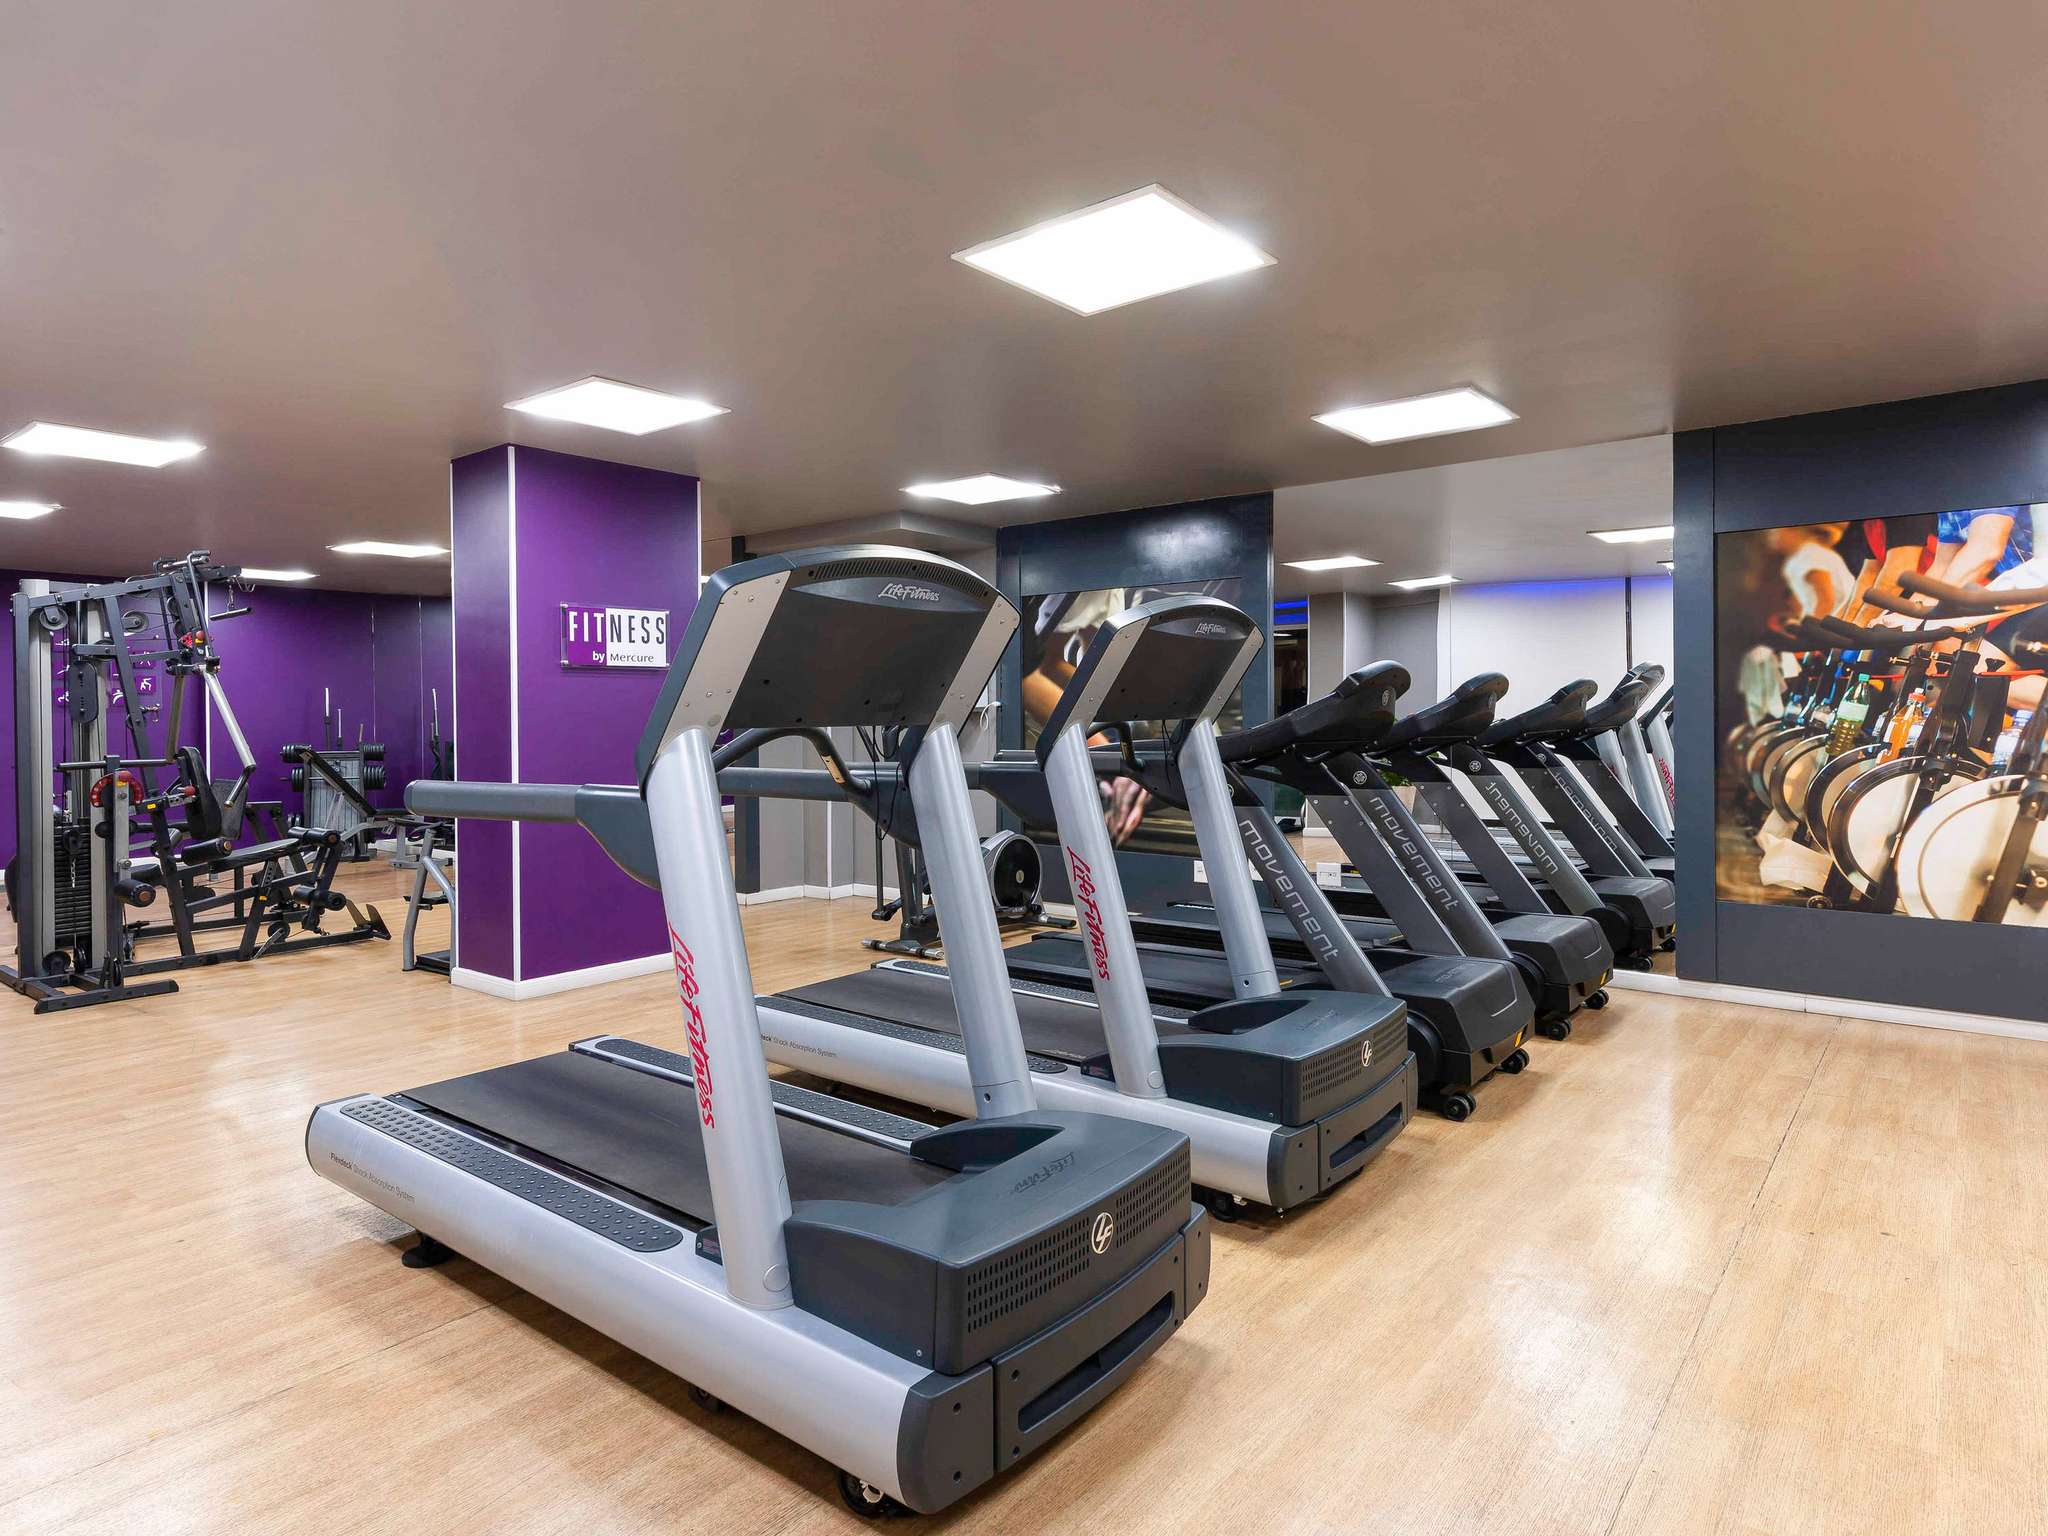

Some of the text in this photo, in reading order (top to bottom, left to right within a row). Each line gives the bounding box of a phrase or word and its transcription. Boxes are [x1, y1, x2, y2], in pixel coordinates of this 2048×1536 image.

[568, 611, 665, 645] FITNESS
[592, 650, 654, 663] by Mercure
[1370, 797, 1459, 910] movement
[1239, 820, 1338, 962] movement
